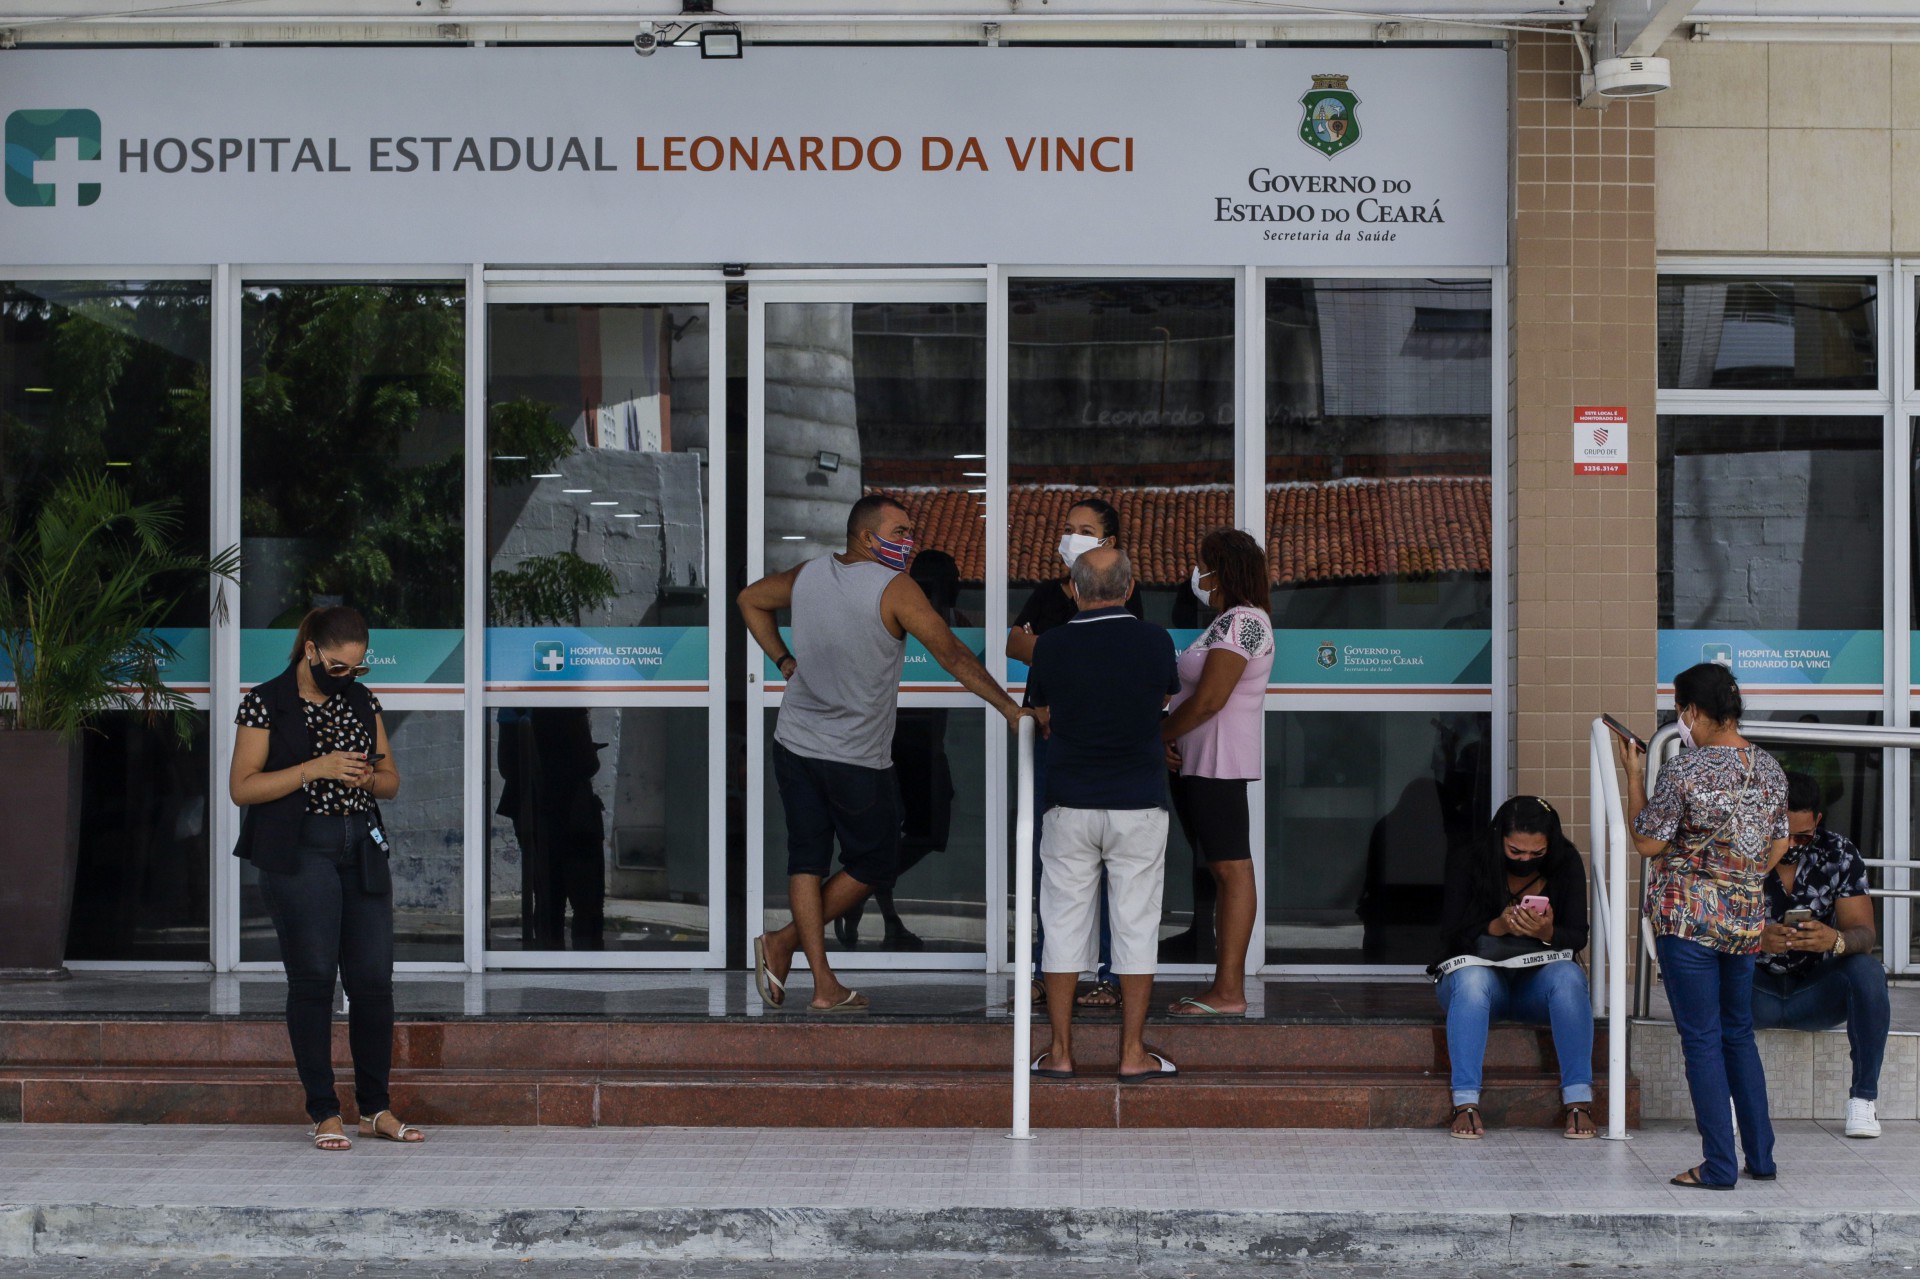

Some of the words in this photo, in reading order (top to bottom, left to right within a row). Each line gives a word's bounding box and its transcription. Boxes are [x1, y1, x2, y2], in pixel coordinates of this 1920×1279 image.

[119, 137, 351, 174] HOSPITAL
[369, 136, 618, 173] ESTADUAL
[636, 135, 902, 172] LEONARDO
[921, 136, 989, 172] DA
[1004, 136, 1134, 173] VINCI
[1248, 167, 1376, 194] GOVERNO
[1382, 179, 1412, 194] DO
[1213, 196, 1315, 223] ESTADO
[1320, 208, 1351, 223] DO
[1356, 197, 1446, 223] CEARÁ
[1262, 229, 1330, 242] Secretaria
[1335, 229, 1351, 242] da
[1356, 229, 1398, 242] Saúde
[1081, 400, 1205, 426] Leonardo
[570, 647, 613, 655] HOSPITAL
[616, 647, 663, 655] ESTADUAL
[1344, 645, 1389, 655] GOVERNO
[1738, 650, 1782, 658] HOSPITAL
[1784, 650, 1831, 658] ESTADUAL
[366, 655, 397, 665] CEARÁ
[570, 657, 620, 665] LEONARDO
[622, 657, 635, 665] DA
[638, 657, 663, 665] VINCI
[904, 653, 928, 663] EARÁ
[1344, 656, 1379, 665] ESTADO
[1393, 655, 1424, 665] CEARÁ
[1738, 660, 1788, 669] LEONARDO
[1790, 660, 1804, 669] DA
[1806, 660, 1831, 669] VINCI
[1453, 957, 1466, 966] LIVE
[1523, 955, 1544, 965] SCHUTZ
[1547, 953, 1560, 961] LOVE
